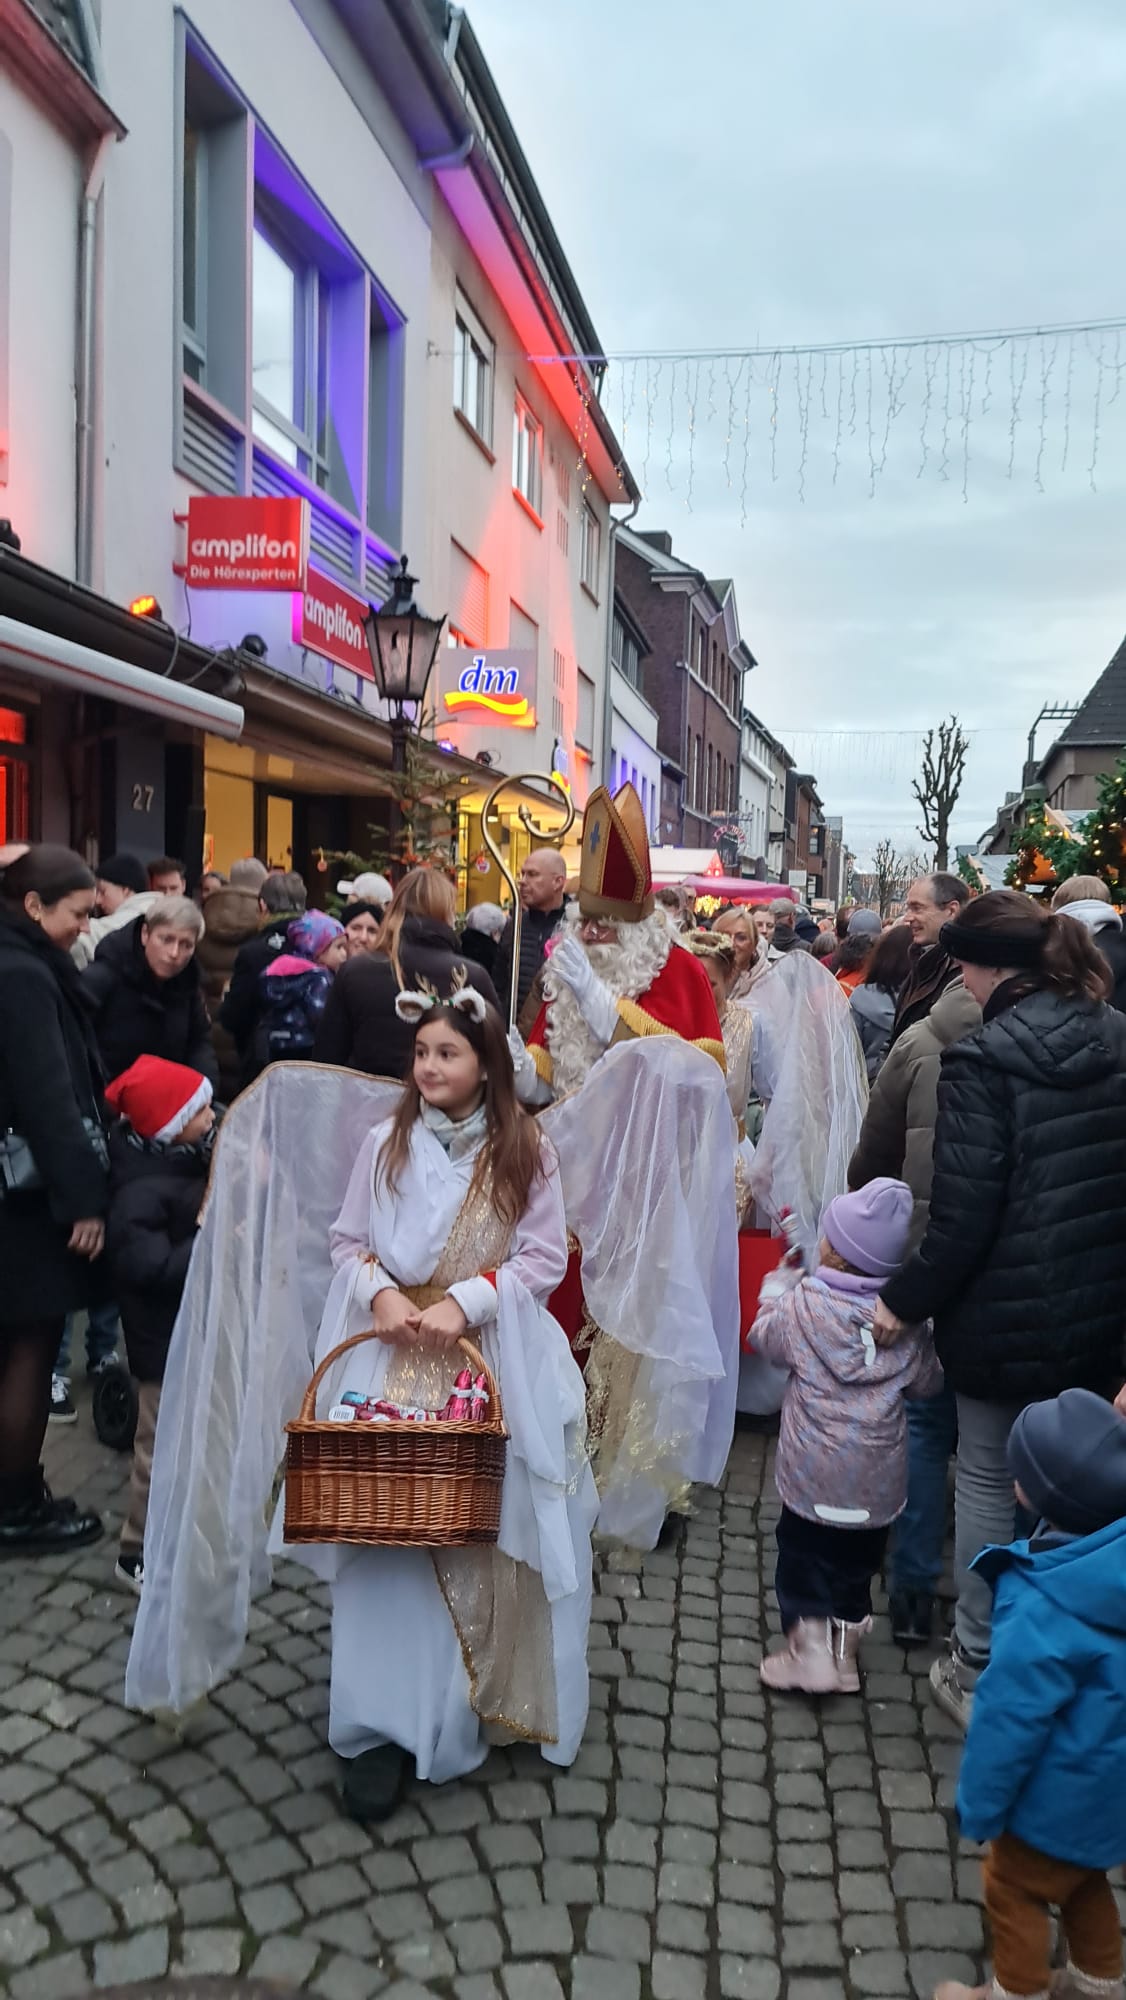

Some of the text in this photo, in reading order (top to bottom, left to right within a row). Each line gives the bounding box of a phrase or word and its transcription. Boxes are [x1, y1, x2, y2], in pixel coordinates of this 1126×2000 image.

[191, 533, 297, 564] amplifon
[190, 565, 296, 583] Die Hörexperten
[305, 592, 361, 651] amplifon
[459, 655, 519, 694] dm
[133, 784, 154, 811] 27
